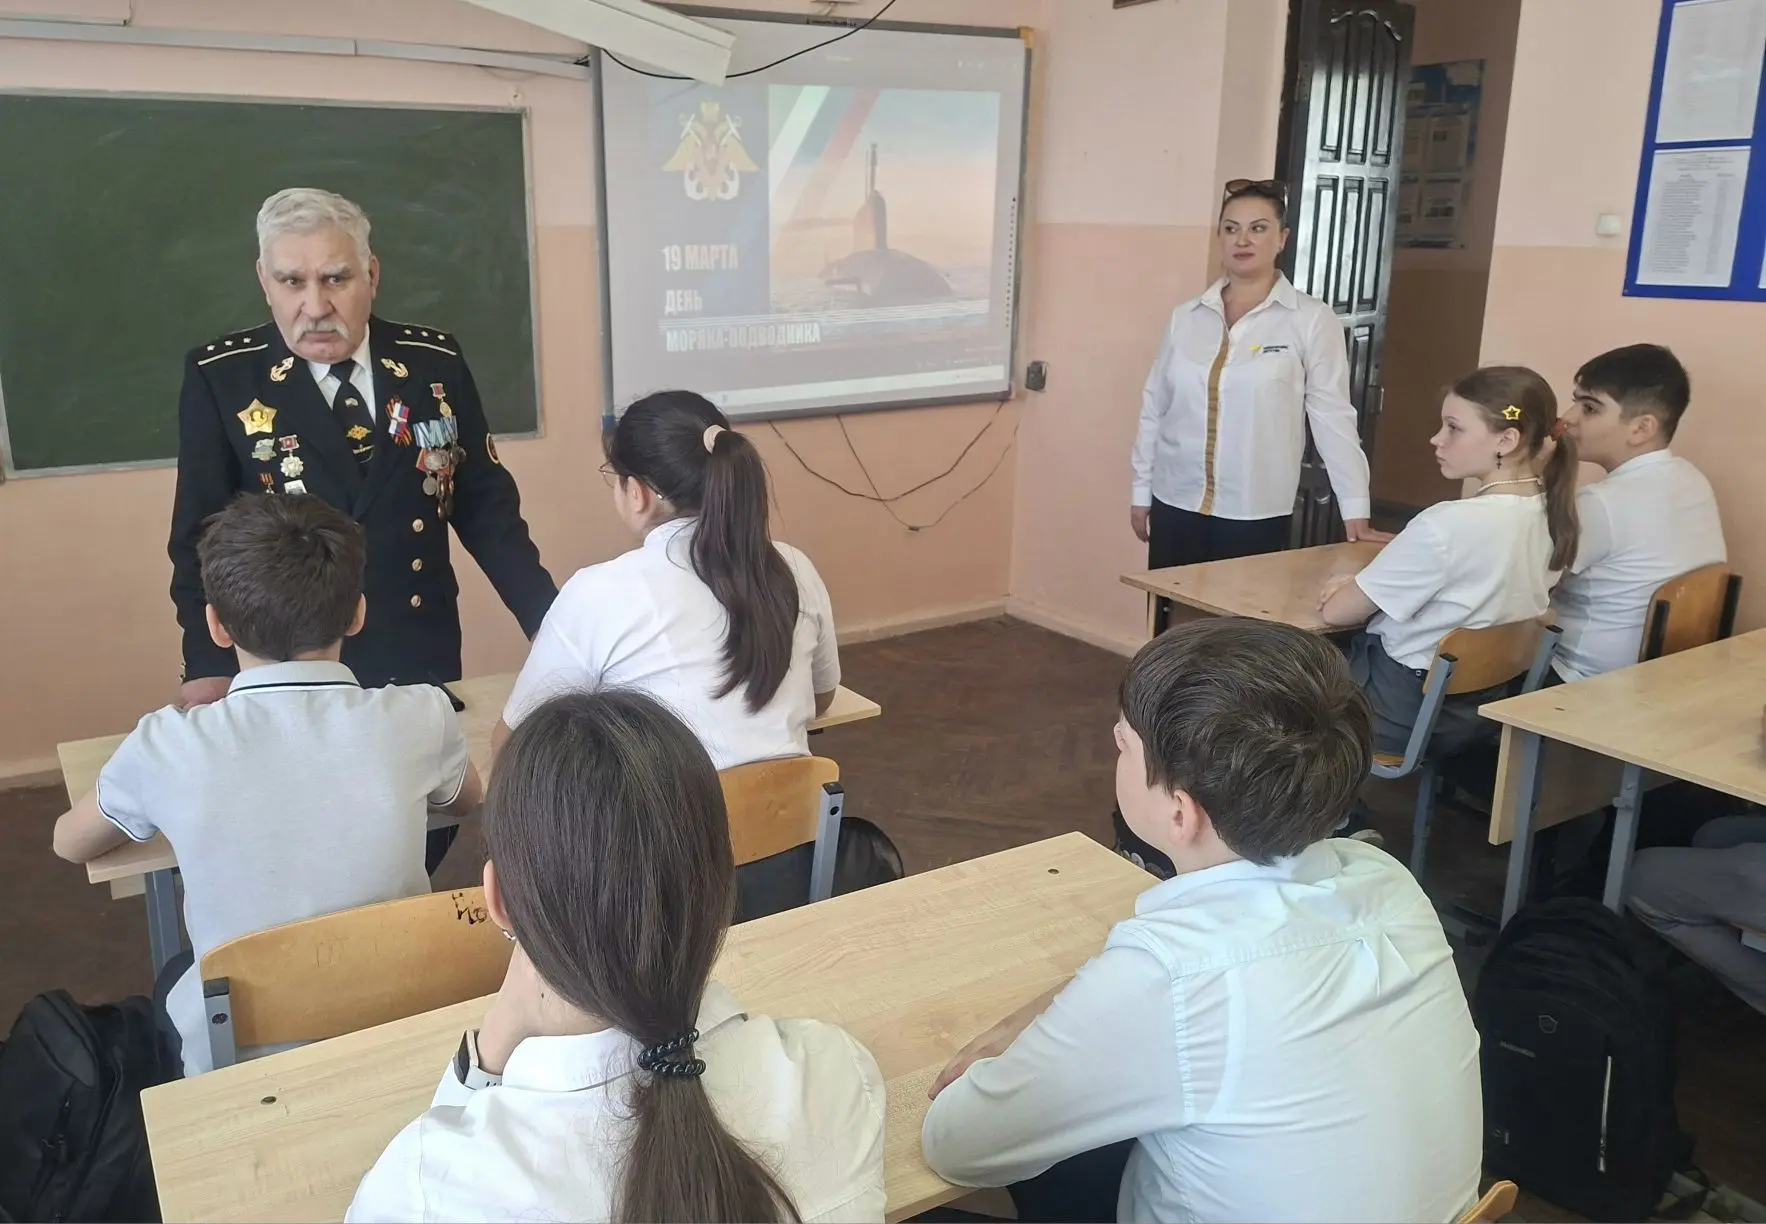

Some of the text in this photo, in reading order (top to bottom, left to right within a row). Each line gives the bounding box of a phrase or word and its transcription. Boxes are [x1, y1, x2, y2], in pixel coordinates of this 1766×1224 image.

[662, 243, 739, 272] 19 МАРТА
[664, 289, 703, 316] ДЕНЬ
[665, 322, 821, 352] МОРЯКА-ПОДВОДНИКА
